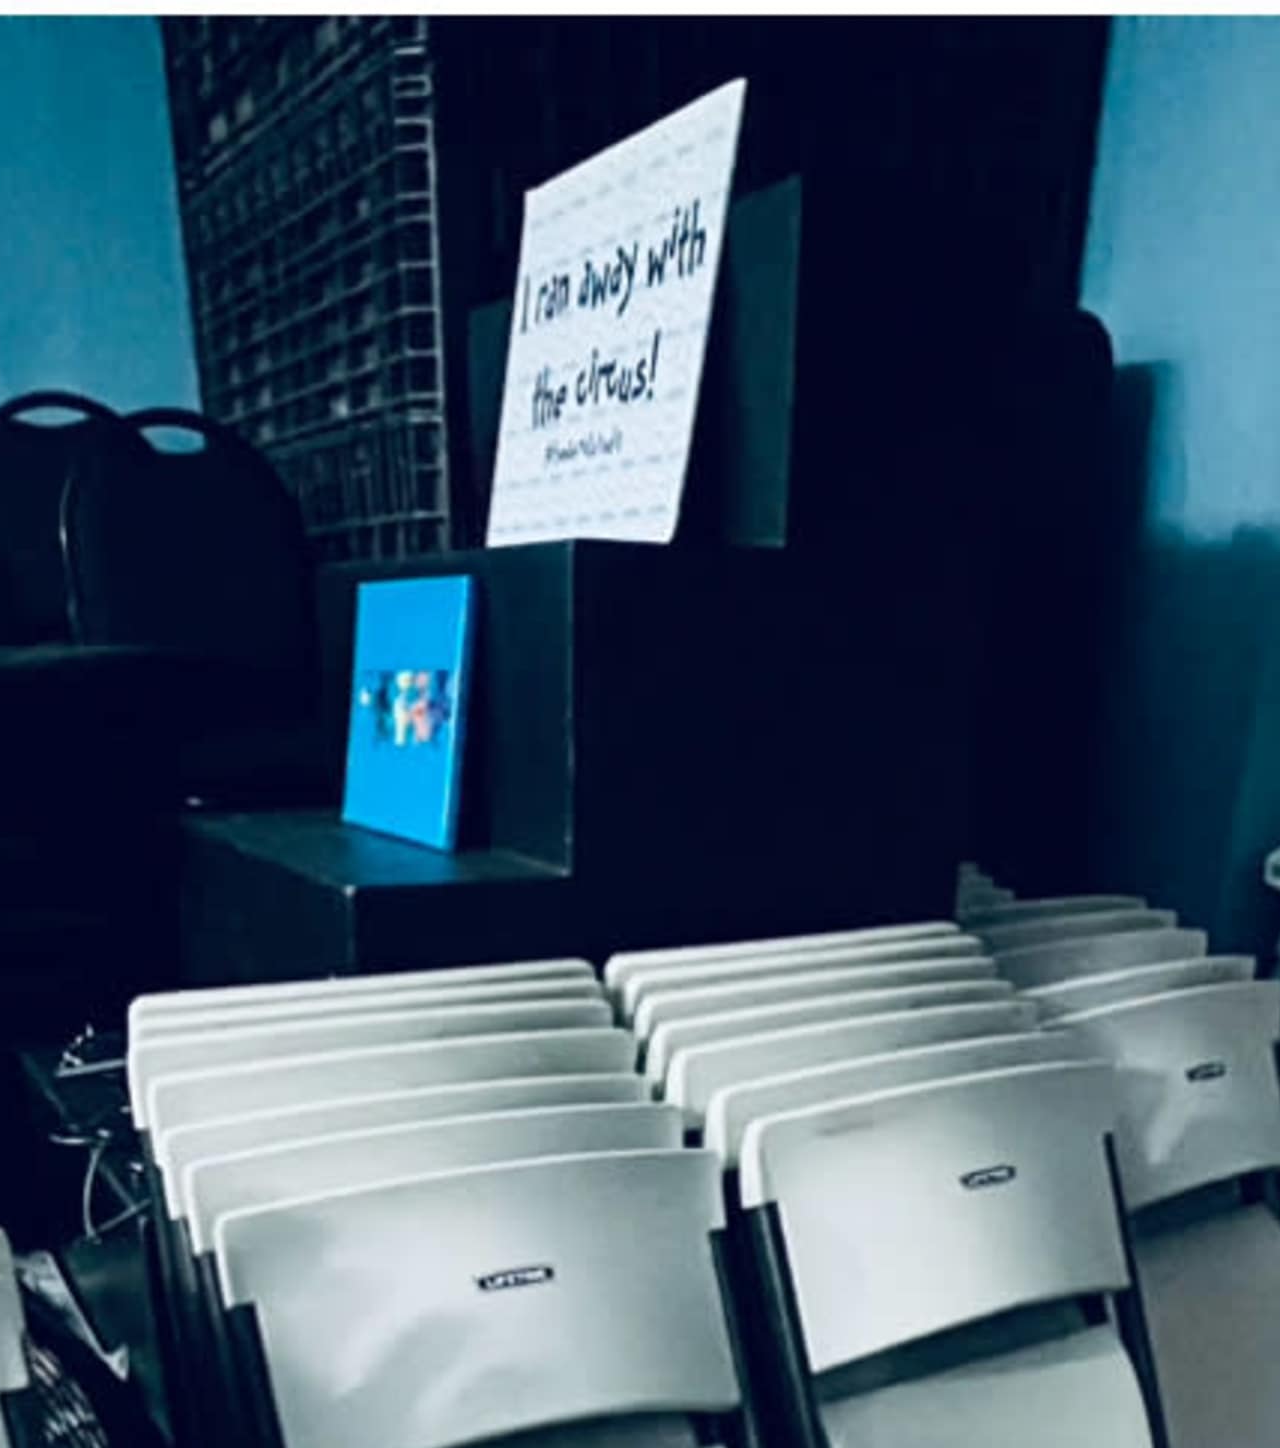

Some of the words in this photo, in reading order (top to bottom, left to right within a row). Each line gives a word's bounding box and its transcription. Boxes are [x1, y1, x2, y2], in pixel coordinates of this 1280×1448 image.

[520, 273, 531, 335] I
[534, 272, 570, 324] ran
[577, 241, 639, 317] away
[646, 197, 707, 288] with
[531, 365, 568, 430] the
[575, 328, 661, 406] circus!
